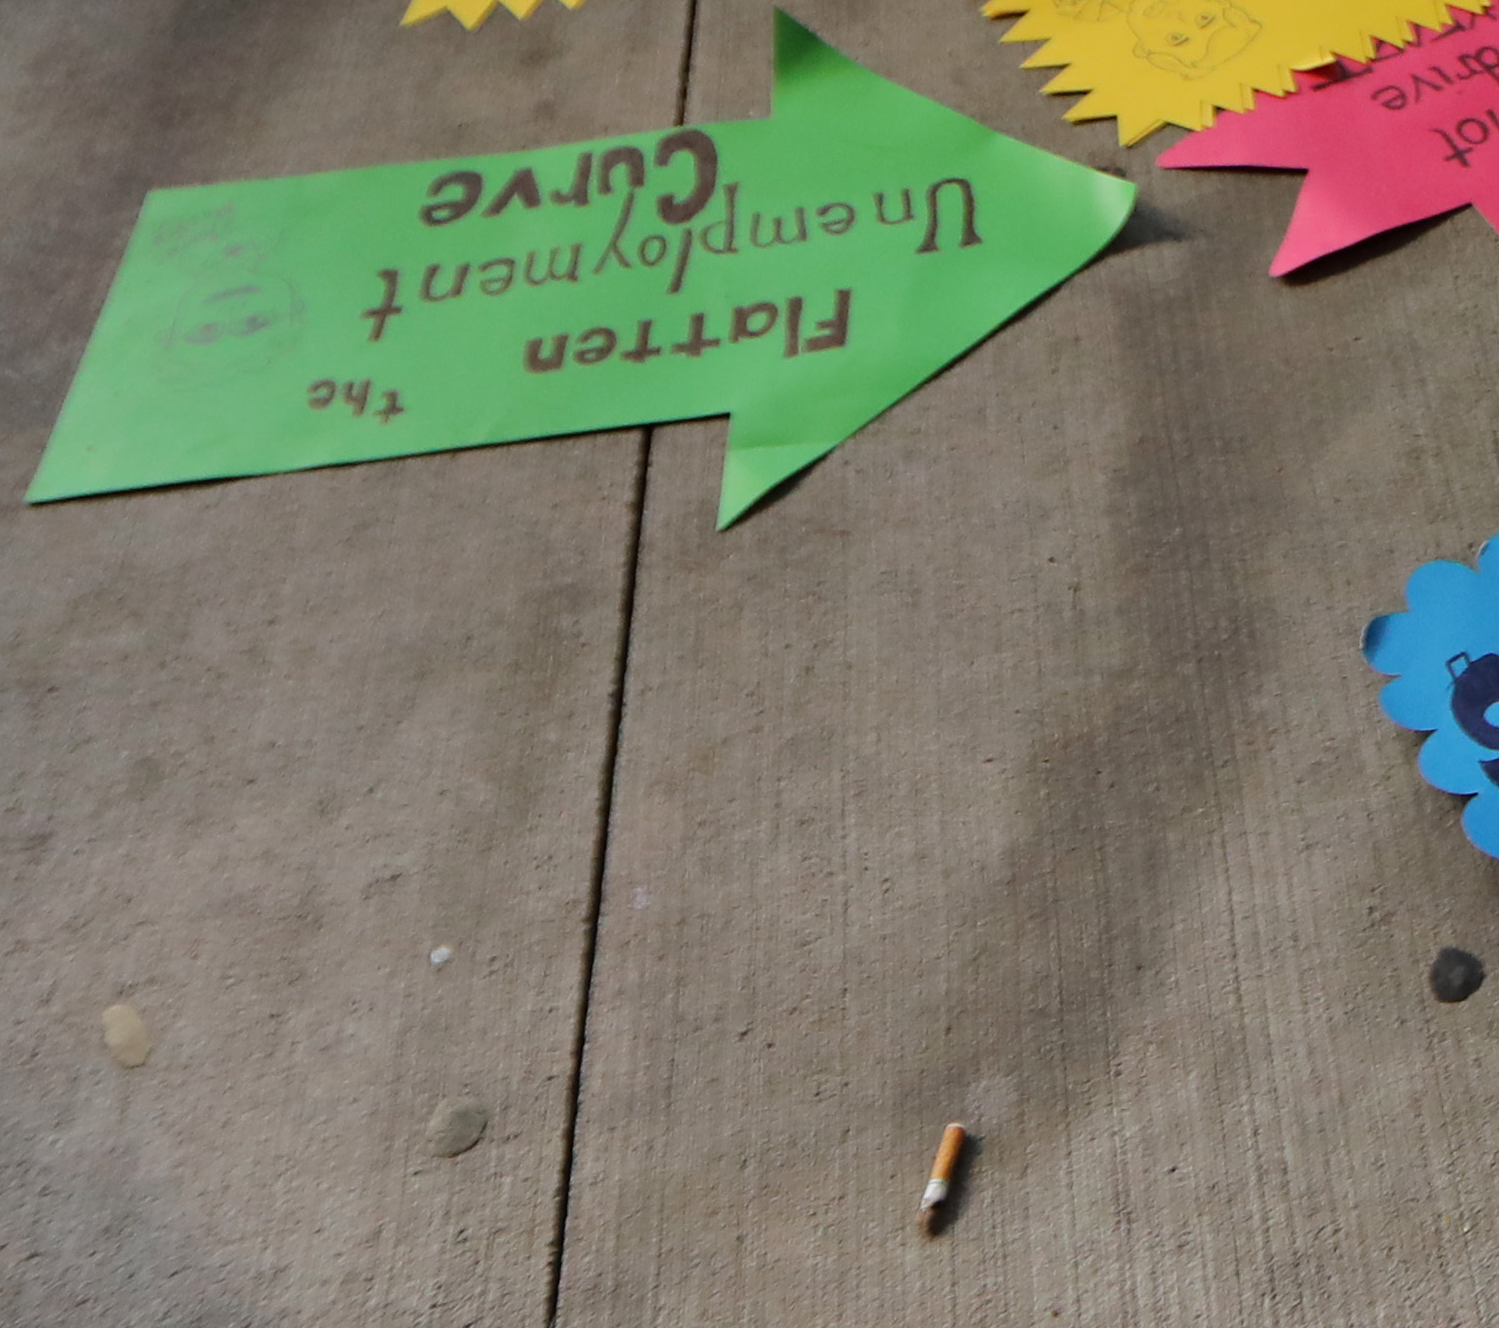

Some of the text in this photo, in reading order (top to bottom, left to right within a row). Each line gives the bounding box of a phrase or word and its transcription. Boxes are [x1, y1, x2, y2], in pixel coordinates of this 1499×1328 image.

[416, 128, 718, 227] Curve
[358, 175, 983, 344] Unemployment
[303, 287, 852, 424] Flatten the
